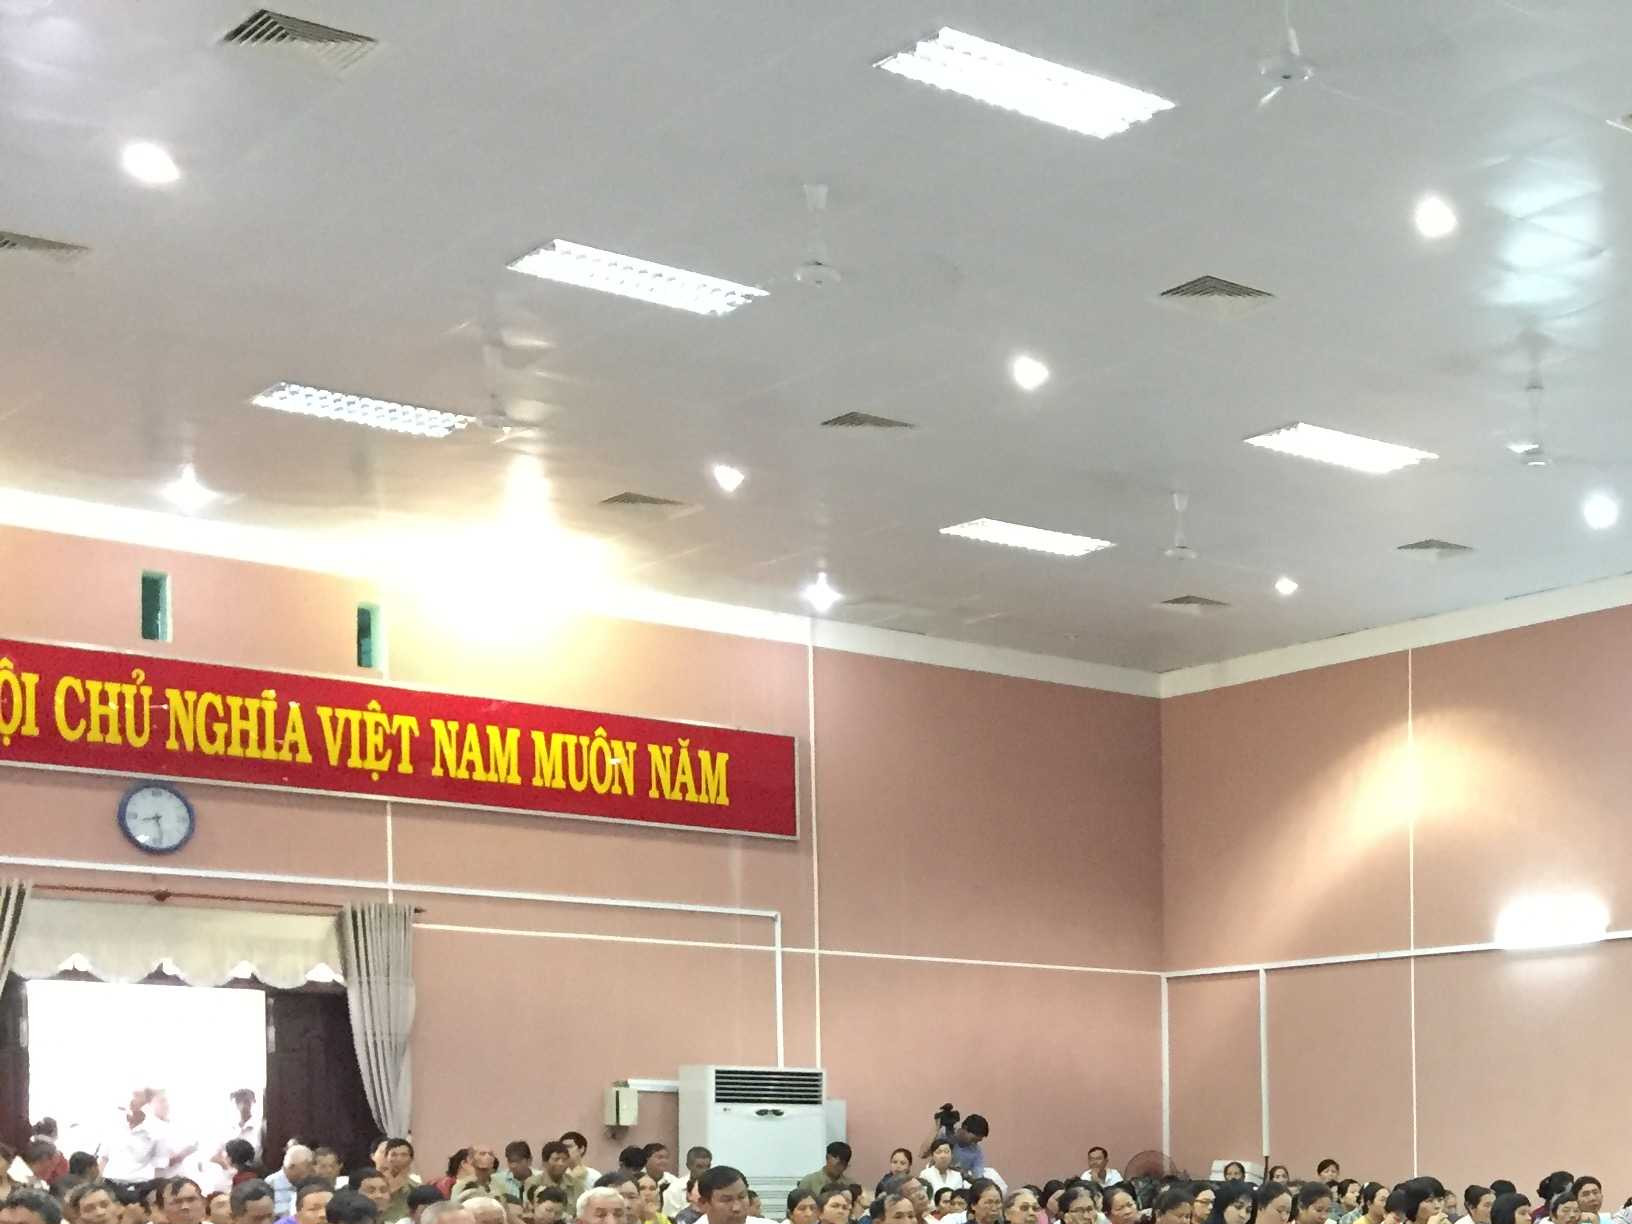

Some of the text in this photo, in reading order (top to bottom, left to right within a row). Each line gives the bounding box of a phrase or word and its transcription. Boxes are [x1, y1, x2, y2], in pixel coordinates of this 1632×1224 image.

[54, 668, 152, 747] CHỦ
[166, 688, 312, 763] NGHĨA
[317, 700, 419, 780] VIỆT
[431, 720, 521, 784] NAM
[531, 727, 637, 795] MUÔN
[648, 739, 729, 805] NĂM
